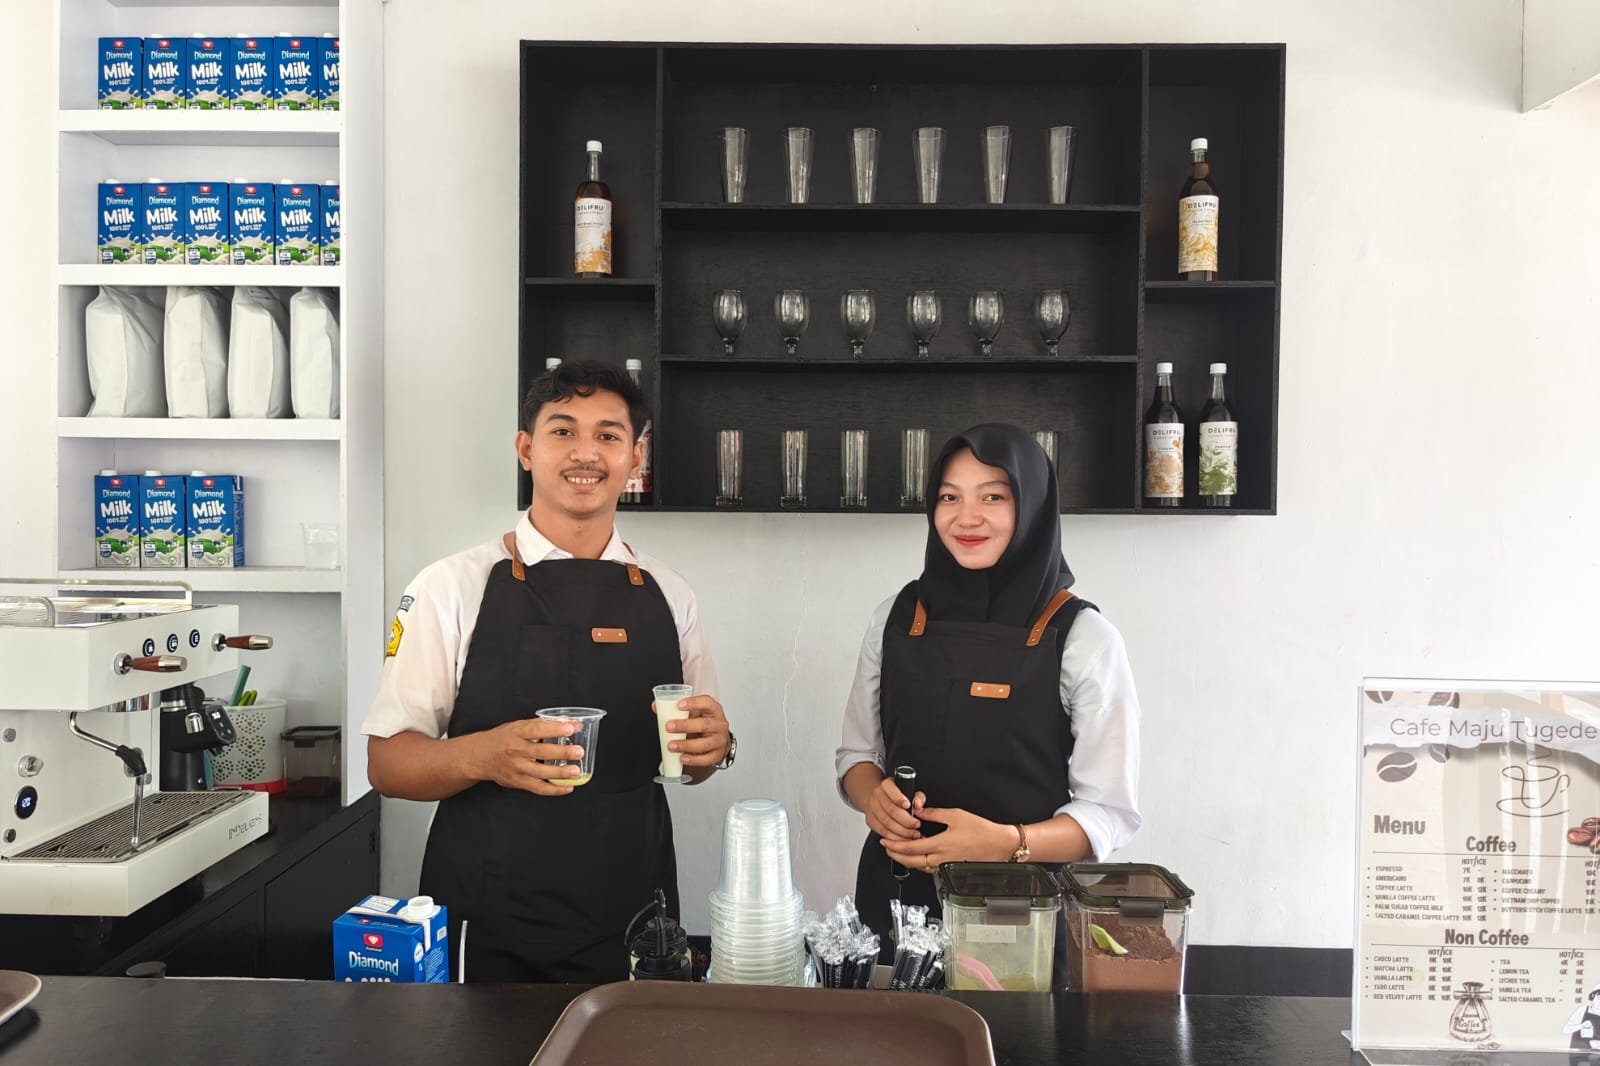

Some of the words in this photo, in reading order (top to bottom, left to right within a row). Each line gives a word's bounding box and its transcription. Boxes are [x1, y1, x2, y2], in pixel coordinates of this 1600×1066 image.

[105, 51, 133, 60] Diamond
[150, 51, 178, 60] Diamond
[194, 51, 222, 60] Diamond
[237, 51, 266, 60] Diamond
[281, 50, 310, 60] Diamond
[103, 61, 135, 80] Milk
[148, 61, 180, 80] Milk
[191, 61, 223, 80] Milk
[235, 61, 267, 80] Milk
[279, 61, 312, 80] Milk
[323, 62, 340, 80] Mi
[105, 197, 134, 206] Diamond
[148, 196, 177, 205] Diamond
[191, 196, 220, 205] Diamond
[236, 197, 265, 206] Diamond
[282, 198, 311, 207] Diamond
[103, 207, 136, 226] Milk
[146, 207, 179, 225] Milk
[189, 207, 222, 225] Milk
[234, 207, 267, 226] Milk
[280, 208, 313, 227] Milk
[102, 488, 131, 498] Diamond
[146, 489, 176, 498] Diamond
[194, 489, 224, 499] Diamond
[100, 499, 133, 518] Milk
[144, 499, 178, 518] Milk
[192, 499, 227, 519] Milk
[1390, 718, 1441, 736] Cafe
[1450, 719, 1504, 742] Maju
[1512, 720, 1598, 743] Tugede
[1374, 815, 1426, 835] Menu
[1466, 836, 1517, 852] Coffee
[1461, 856, 1487, 867] HOT/ICE
[1445, 929, 1475, 945] Non
[1478, 929, 1529, 945] Coffee
[1428, 947, 1453, 957] HOT/ICE
[1559, 949, 1584, 959] HOT/ICE
[348, 951, 399, 976] Diamond
